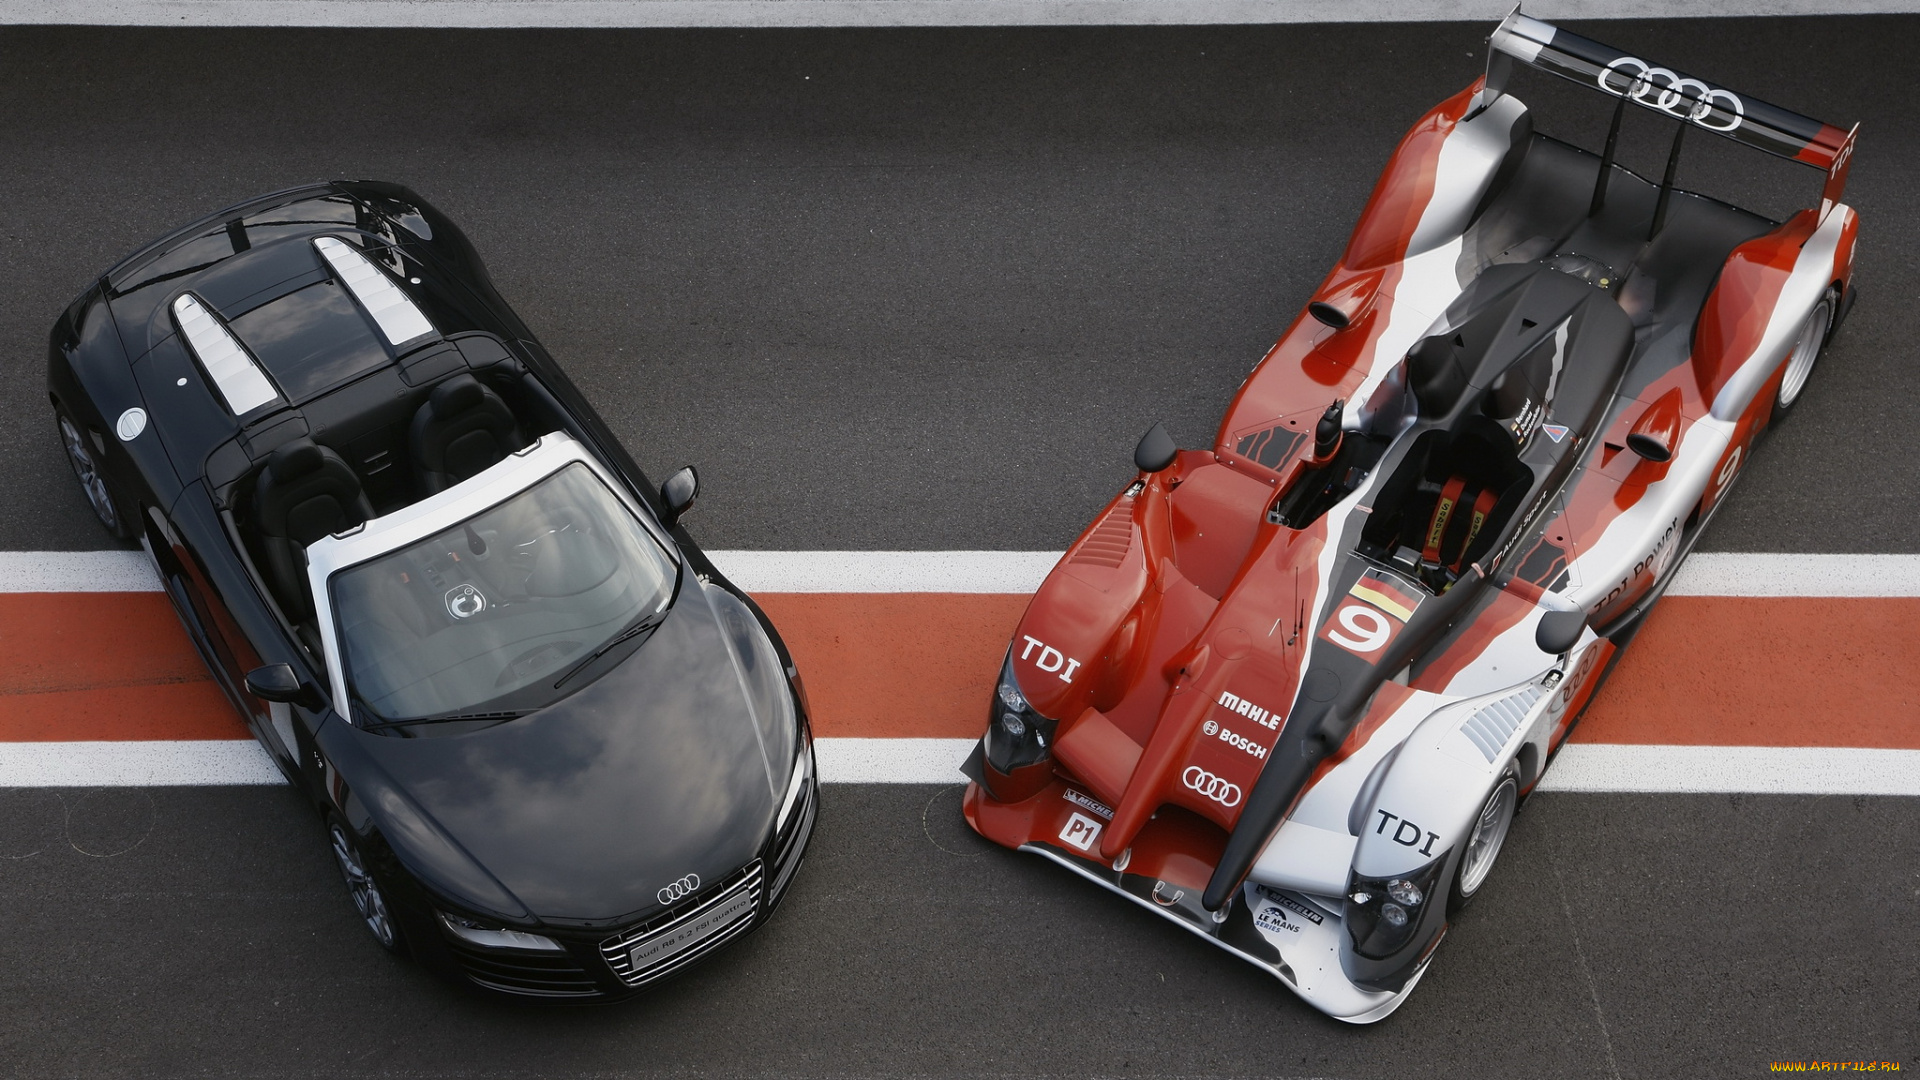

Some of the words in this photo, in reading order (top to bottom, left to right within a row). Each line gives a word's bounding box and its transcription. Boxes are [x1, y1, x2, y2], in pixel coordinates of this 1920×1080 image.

[1831, 134, 1857, 180] TDI
[1515, 397, 1531, 424] Bernhard
[1715, 445, 1742, 499] 9
[1502, 524, 1523, 557] Audi
[1523, 490, 1547, 527] Sport
[1594, 577, 1628, 613] TDI
[1633, 516, 1678, 581] Power
[1328, 605, 1391, 653] 9
[1021, 634, 1081, 684] TDI
[1218, 691, 1282, 730] MAHLE
[1219, 728, 1267, 759] BOSCH
[1066, 819, 1095, 845] P1
[1376, 809, 1440, 858] TDI
[637, 946, 659, 961] Audi
[662, 940, 675, 949] R8
[678, 930, 693, 941] 5.2
[695, 920, 710, 932] FSI
[712, 900, 747, 923] quattro
[1255, 920, 1281, 933] SERIES
[1258, 913, 1270, 922] LE
[1271, 918, 1300, 933] MANS
[1270, 892, 1322, 923] MICHELIN
